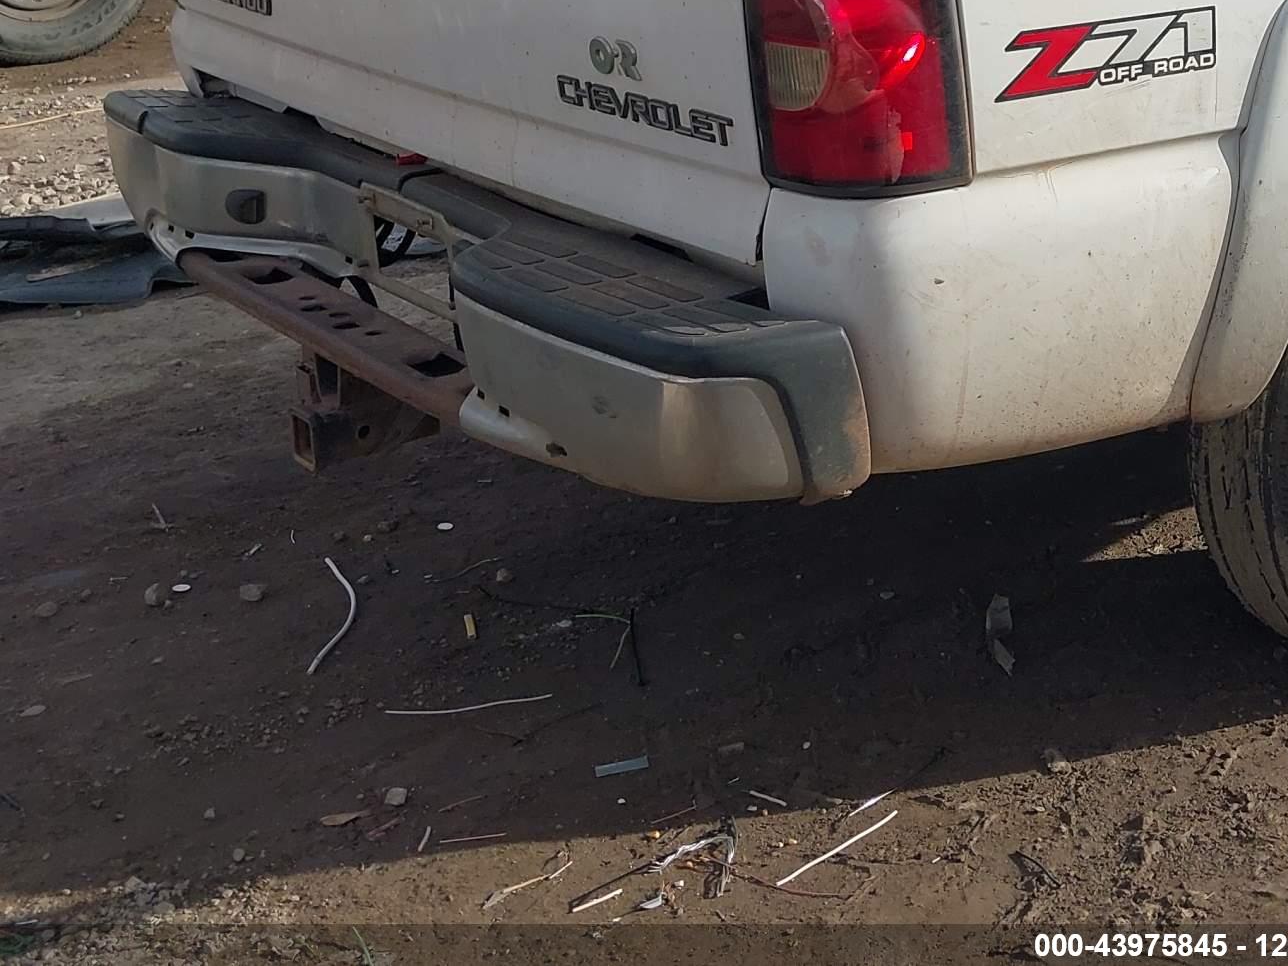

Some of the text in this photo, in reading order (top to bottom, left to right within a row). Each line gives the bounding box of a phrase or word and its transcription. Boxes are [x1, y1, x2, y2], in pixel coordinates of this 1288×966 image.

[995, 5, 1216, 103] Z71
[1099, 52, 1215, 84] OFF ROAD
[557, 74, 734, 147] CHEVROLET
